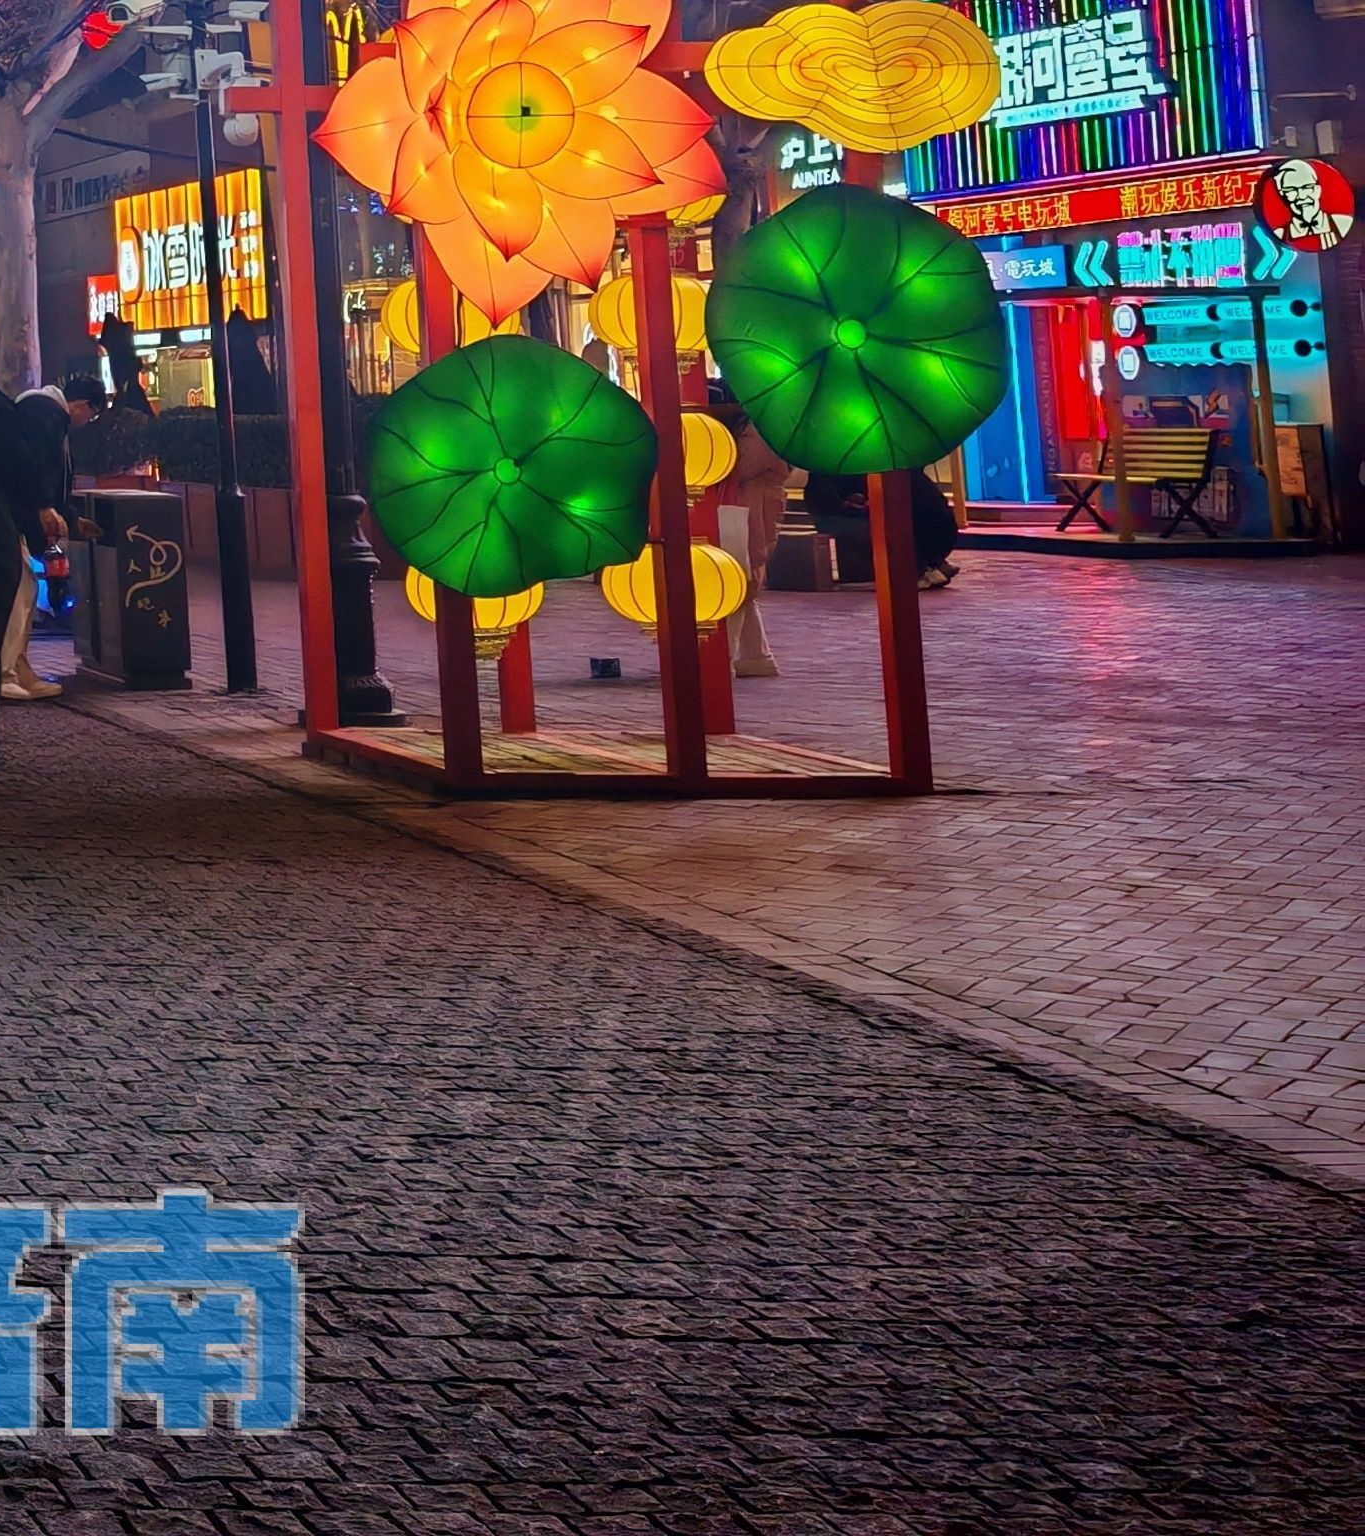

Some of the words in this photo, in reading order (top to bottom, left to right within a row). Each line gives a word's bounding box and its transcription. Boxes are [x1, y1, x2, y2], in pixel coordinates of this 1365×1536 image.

[780, 133, 844, 170] 沪上
[791, 167, 841, 190] AUNTEA
[947, 195, 1071, 235] 银河壹号电玩城
[1145, 308, 1201, 321] WELCOME
[1225, 305, 1283, 318] WELCME
[1148, 346, 1204, 360] WELCOME
[1228, 344, 1288, 357] WELCME
